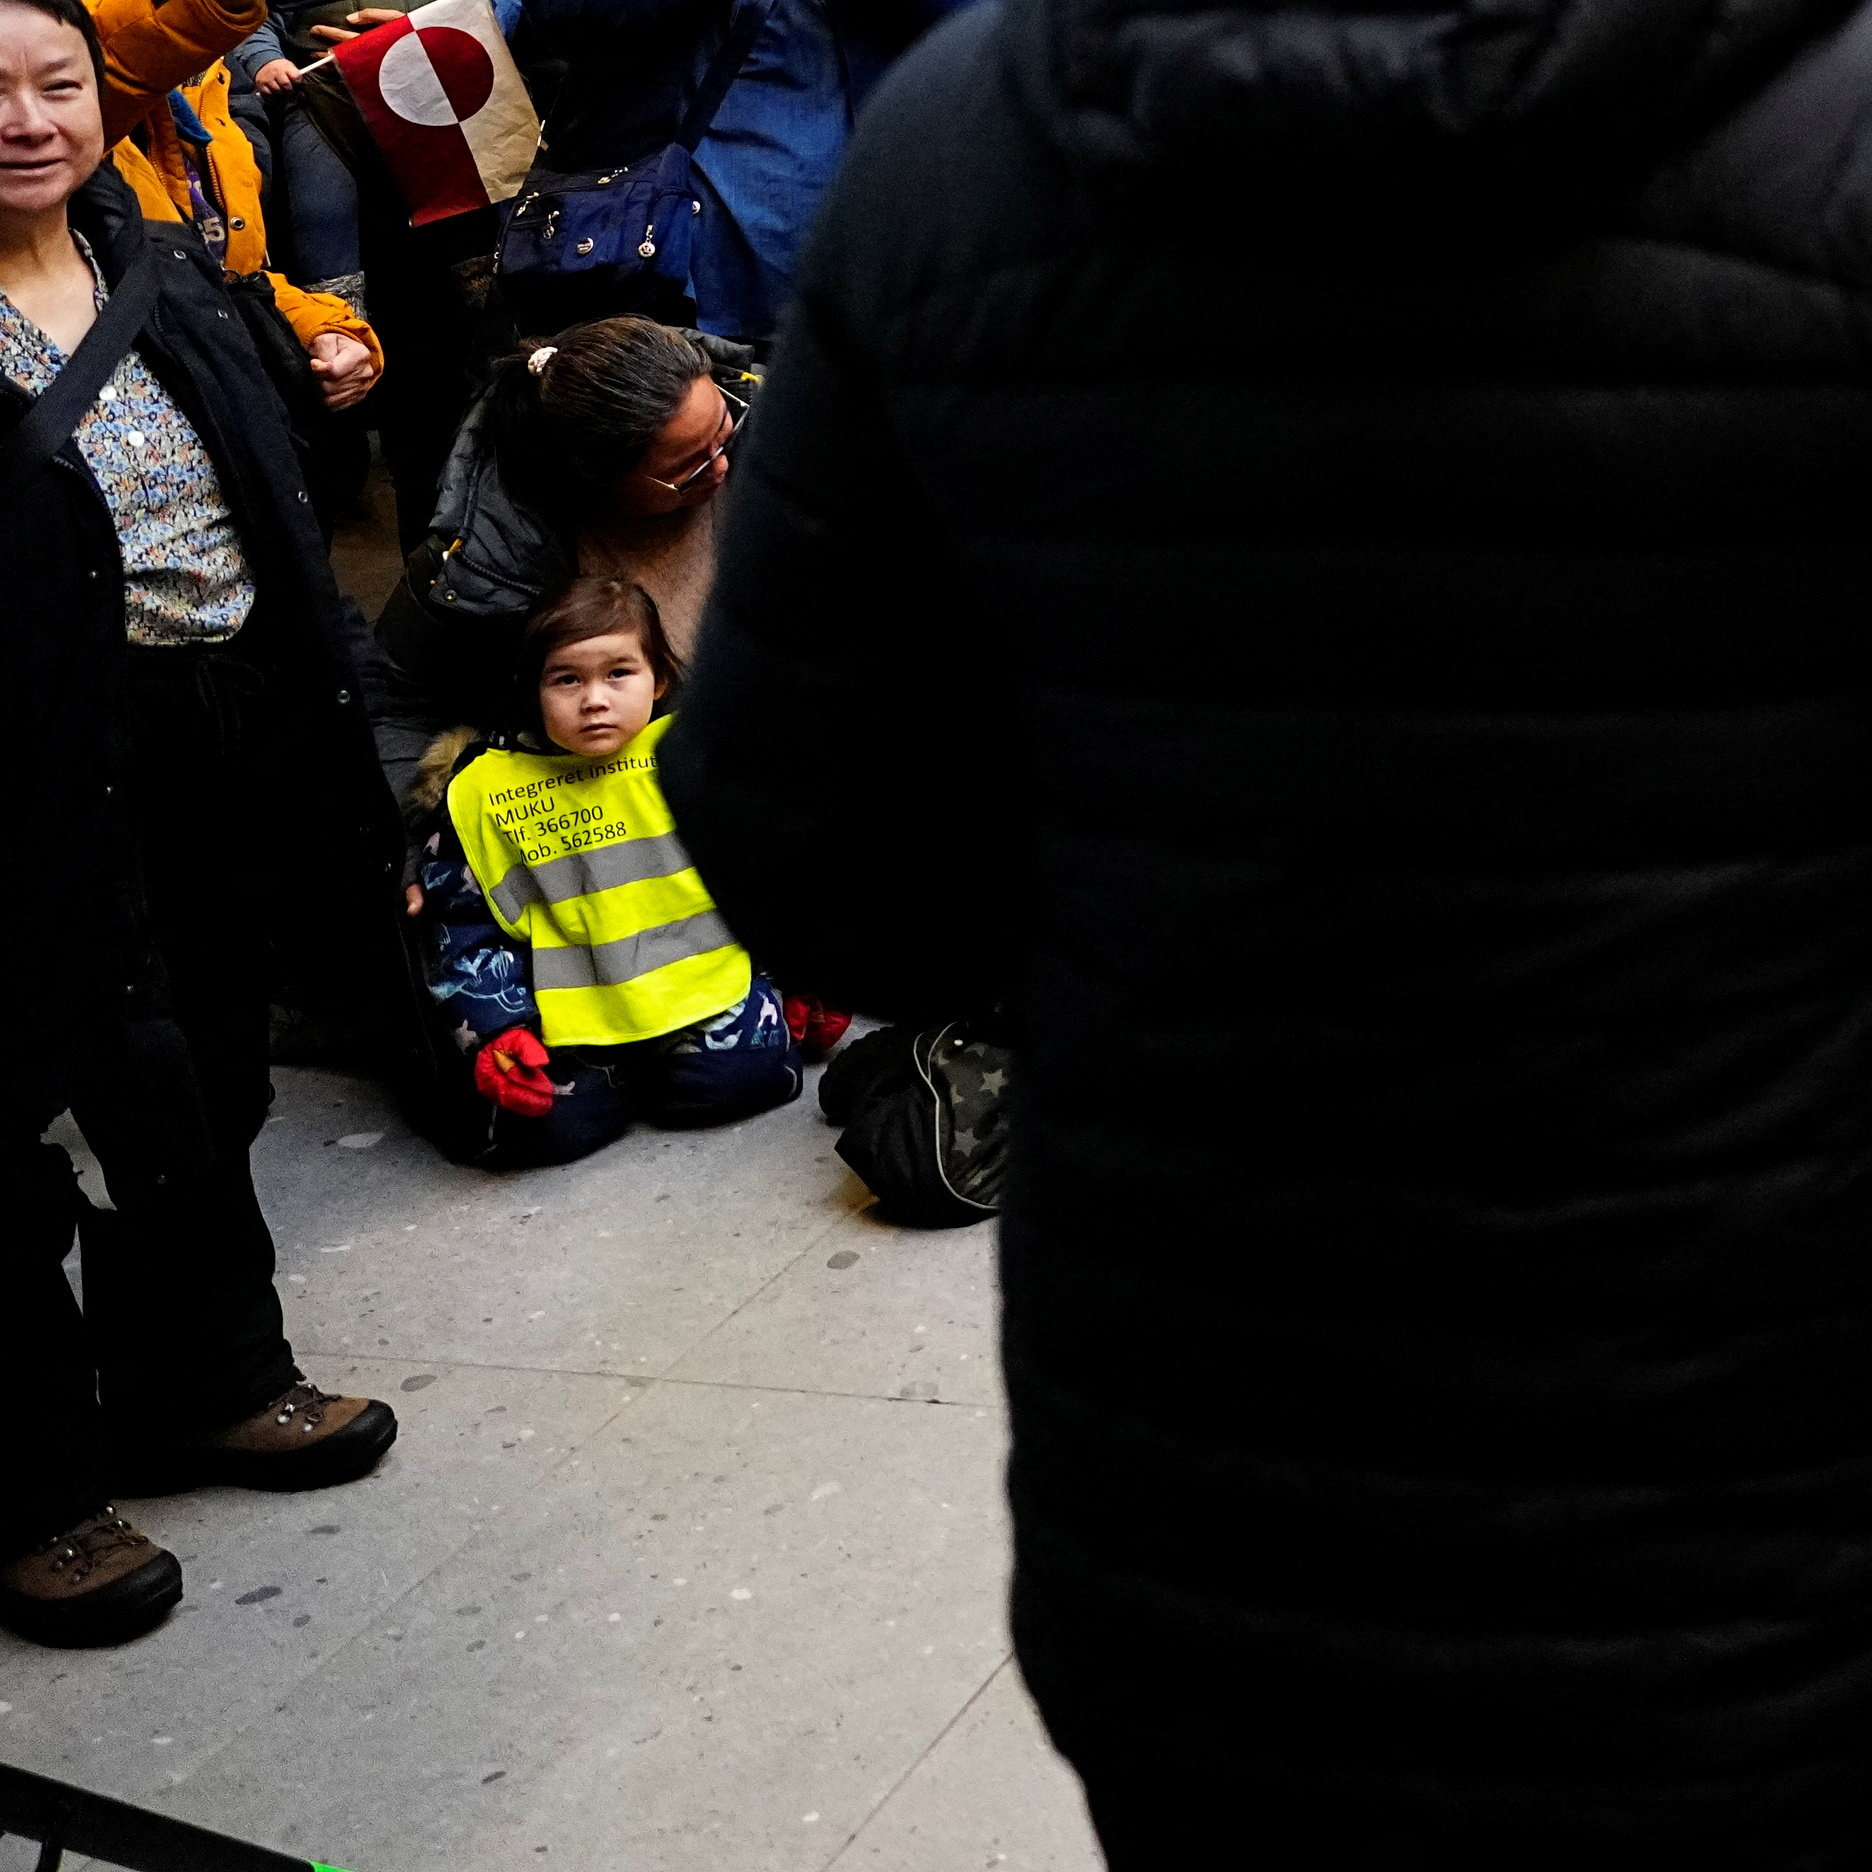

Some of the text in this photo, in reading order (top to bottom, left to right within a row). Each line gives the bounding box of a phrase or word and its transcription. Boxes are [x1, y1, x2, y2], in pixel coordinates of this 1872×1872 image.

[488, 768, 585, 807] Integreret
[495, 795, 555, 827] MUKU
[503, 805, 604, 846] Tlf. 366700
[561, 821, 627, 851] 562588
